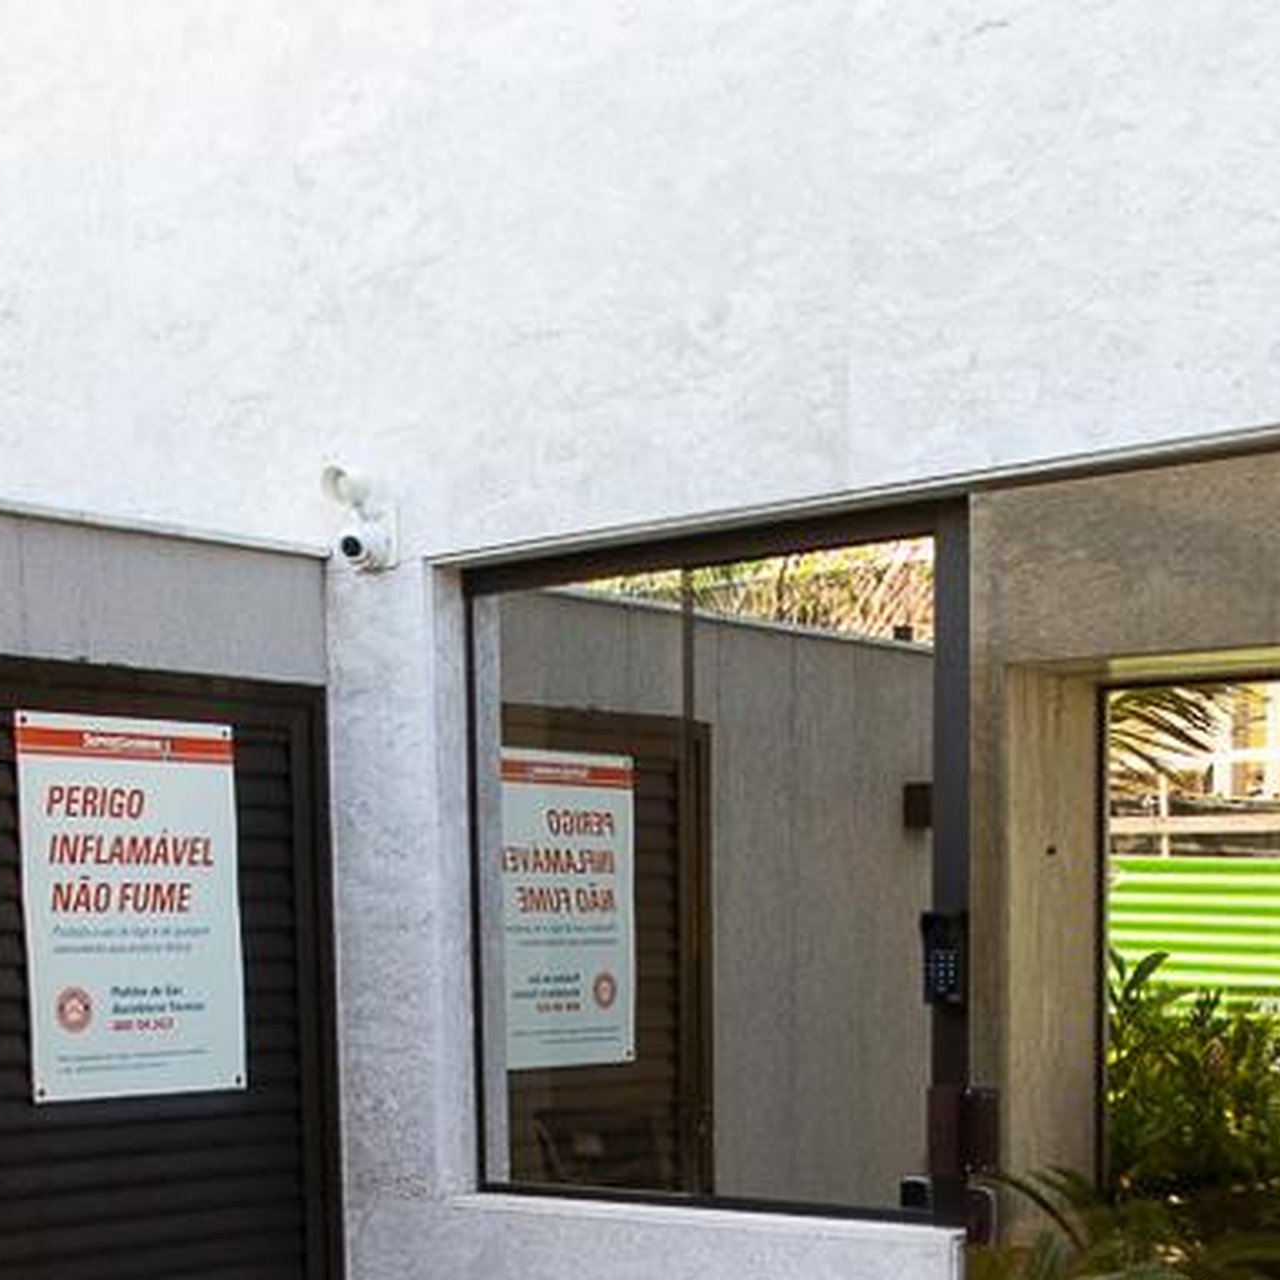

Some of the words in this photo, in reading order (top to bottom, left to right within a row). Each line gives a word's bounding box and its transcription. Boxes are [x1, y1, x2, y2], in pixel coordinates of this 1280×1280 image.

[46, 784, 145, 820] PERIGO
[48, 827, 214, 866] INFLAMÁVEL
[51, 875, 112, 913] NÃO
[118, 882, 192, 913] FUME
